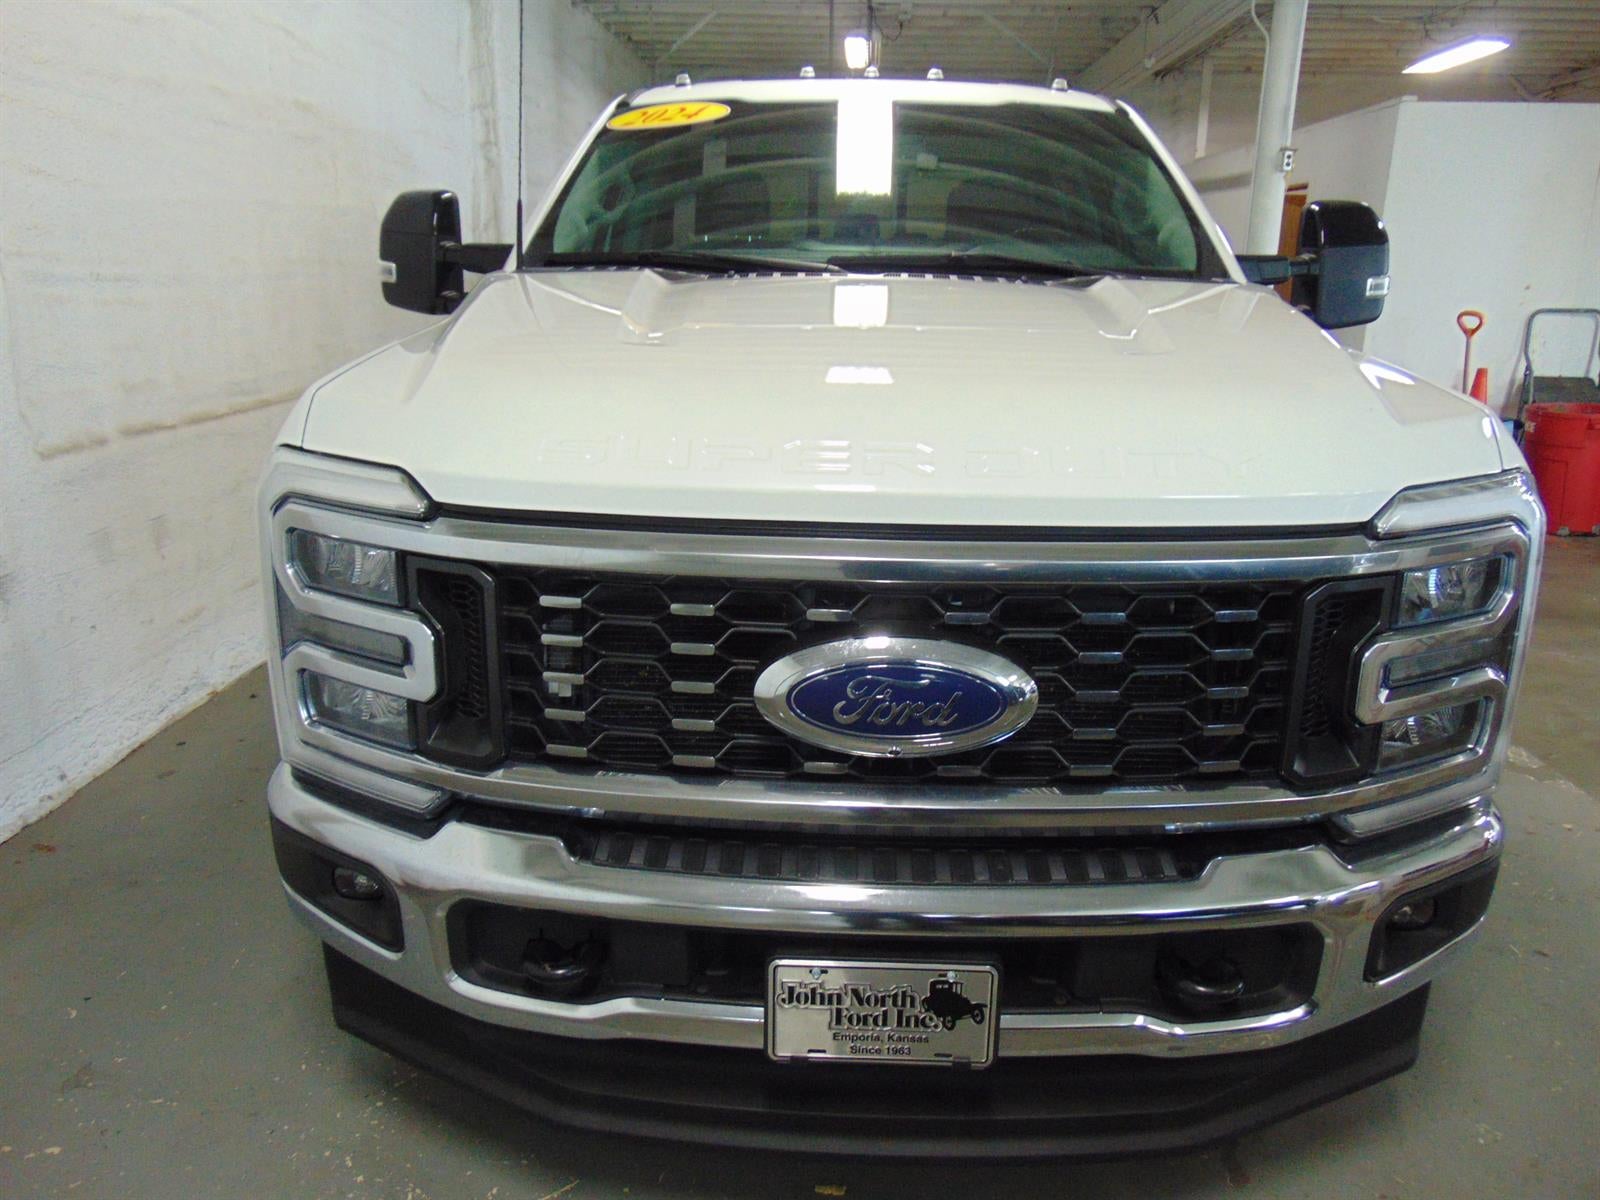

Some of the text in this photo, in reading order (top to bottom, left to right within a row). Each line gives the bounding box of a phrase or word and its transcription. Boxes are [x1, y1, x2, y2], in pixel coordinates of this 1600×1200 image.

[535, 431, 1260, 479] SUPER DUTY
[832, 674, 962, 726] Ford
[779, 984, 917, 1010] John North
[832, 1006, 889, 1028] Ford
[832, 1031, 930, 1044] Emporia, Kansas
[849, 1044, 912, 1056] Since 1963
